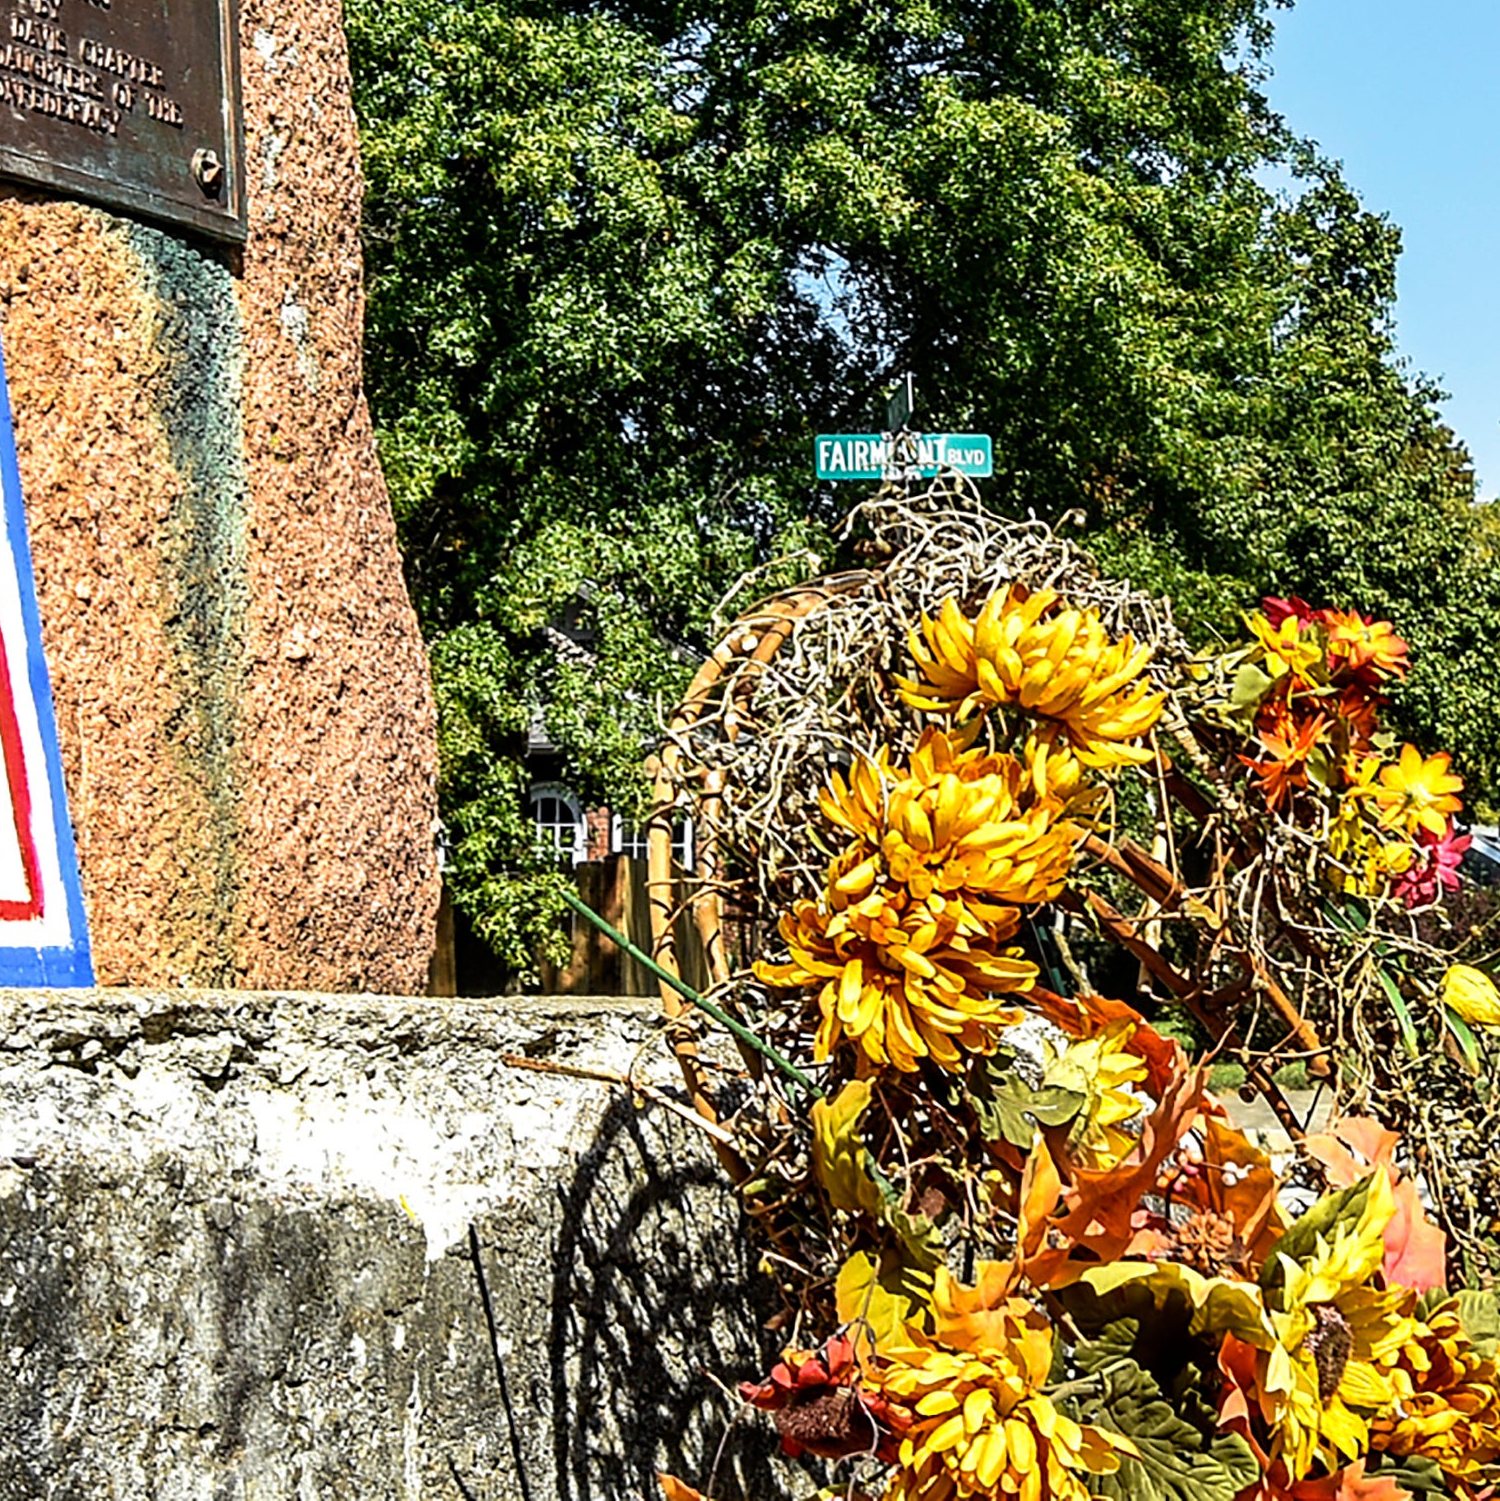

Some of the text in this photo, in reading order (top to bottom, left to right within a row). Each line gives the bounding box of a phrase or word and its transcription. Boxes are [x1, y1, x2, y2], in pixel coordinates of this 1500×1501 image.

[11, 12, 67, 57] DAVIS
[79, 38, 165, 91] CHAPTER
[112, 82, 137, 113] OF
[145, 92, 183, 129] THE
[949, 450, 985, 466] BLVD
